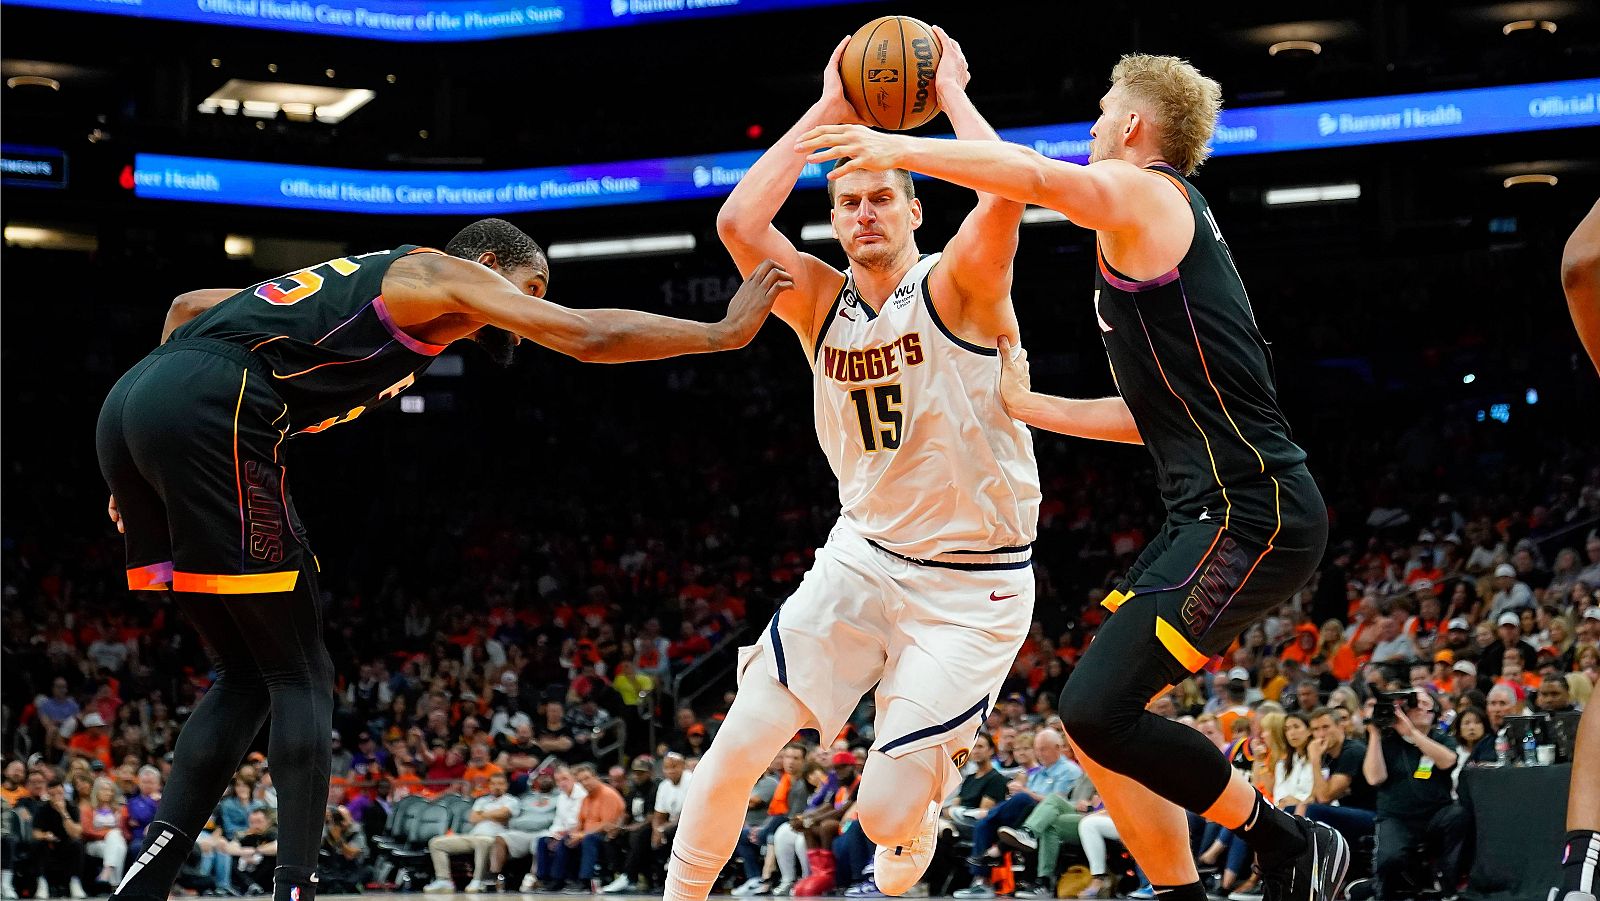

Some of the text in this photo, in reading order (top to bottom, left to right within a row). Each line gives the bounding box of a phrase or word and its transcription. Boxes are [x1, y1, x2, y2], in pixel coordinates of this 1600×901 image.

[260, 0, 315, 22] Health
[315, 4, 354, 25] Care
[355, 7, 413, 30] Partner
[415, 10, 436, 30] of
[436, 10, 464, 30] the
[465, 9, 525, 30] Phoenix
[525, 6, 565, 24] Suns
[911, 36, 935, 114] Wilson
[1338, 103, 1463, 134] Banner Health
[1528, 93, 1595, 118] Official
[165, 168, 220, 191] Health
[280, 176, 640, 203] Official Health Care Partner of the Phoenix Suns
[893, 282, 916, 300] WU
[823, 331, 926, 384] NUGGETS
[849, 383, 904, 453] 15
[244, 460, 283, 563] SUNS
[1181, 537, 1249, 636] SUNS
